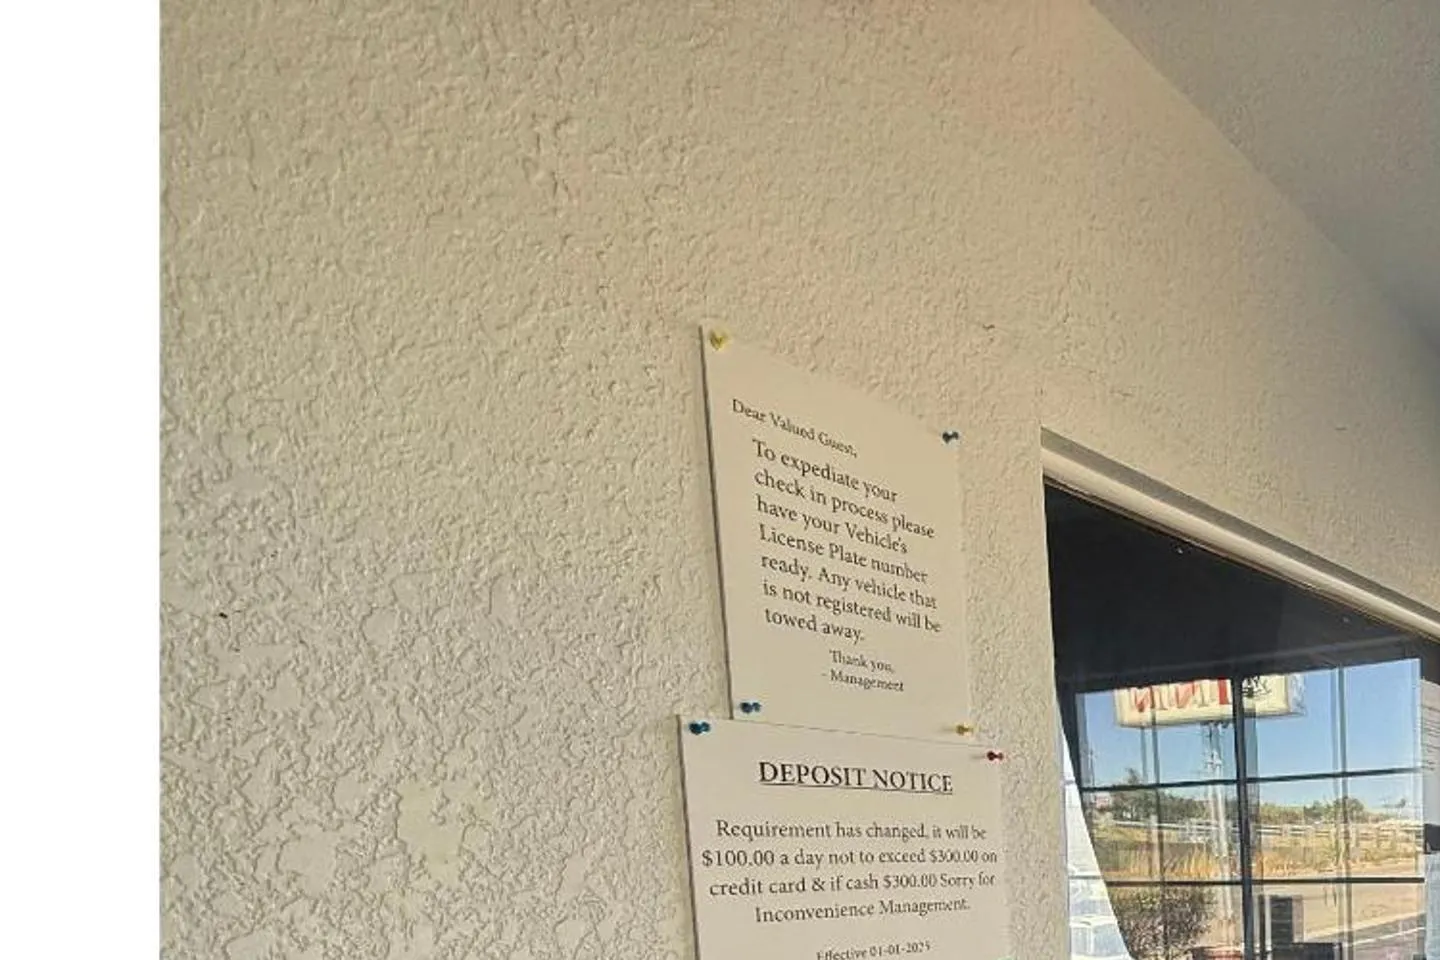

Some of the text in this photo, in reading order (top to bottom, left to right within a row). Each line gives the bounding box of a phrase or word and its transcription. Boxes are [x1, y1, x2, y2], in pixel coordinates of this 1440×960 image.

[732, 399, 766, 422] Dear
[770, 412, 815, 441] Valued
[752, 438, 898, 504] To expediate your
[754, 470, 935, 539] check in process please
[757, 495, 908, 554] have your Vehicle's
[759, 524, 929, 583] License Plate number
[761, 555, 937, 609] ready. Any vehicle that
[763, 580, 941, 633] is not registered will be
[765, 608, 866, 642] towed away.
[829, 650, 868, 669] Thank
[830, 669, 904, 692] Management
[758, 761, 953, 794] DEPOSIT NOTICE
[716, 819, 833, 844] Requirement
[836, 822, 863, 838] has
[932, 825, 942, 839] it
[944, 825, 970, 840] will
[971, 826, 987, 840] be
[702, 849, 998, 870] $100.00 a day not to exceed $300.00 on
[709, 872, 996, 897] credit card & if cash $300.00 Sorry for
[755, 899, 971, 924] Inconvenience Management.
[869, 942, 930, 960] 01-01-2025
